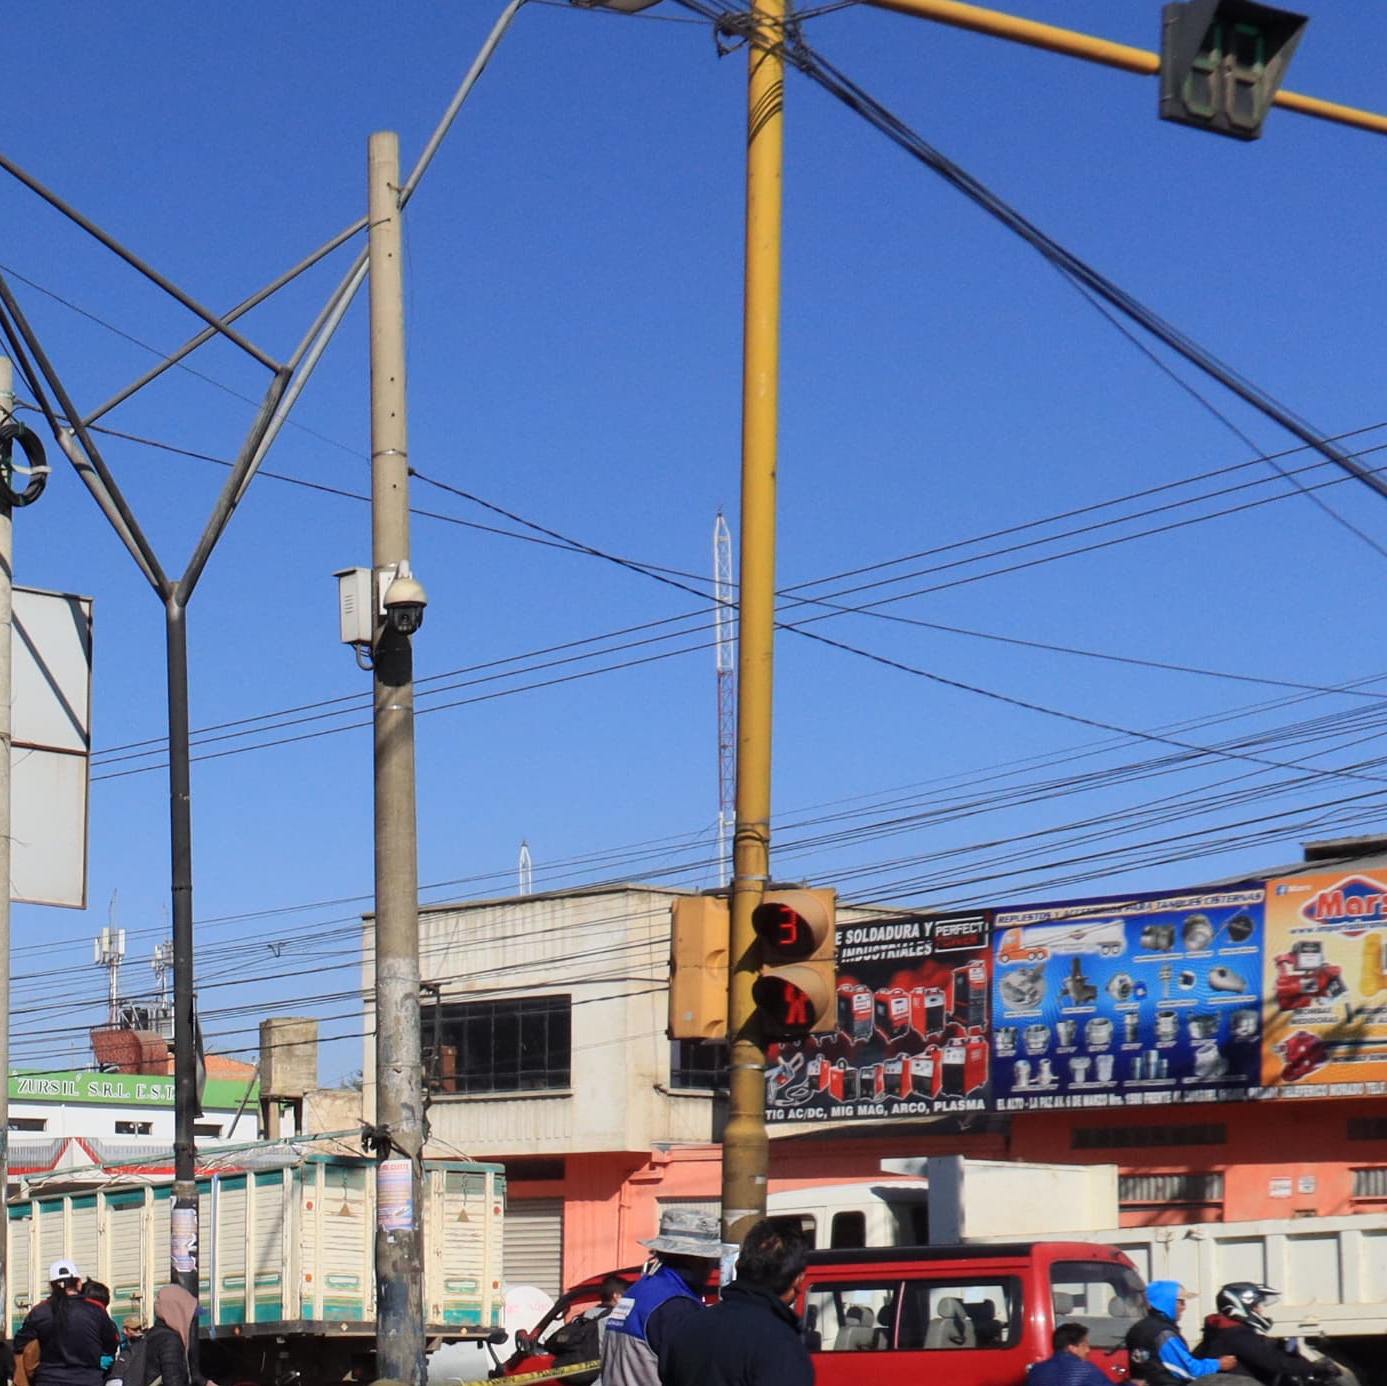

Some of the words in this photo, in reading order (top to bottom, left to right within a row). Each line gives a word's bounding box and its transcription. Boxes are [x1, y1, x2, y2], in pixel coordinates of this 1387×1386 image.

[997, 911, 1052, 924] REPUESTOS
[1203, 892, 1263, 906] CISTERNAS
[845, 922, 920, 945] SOLDADURA
[924, 920, 934, 937] Y
[935, 921, 984, 938] PERFECT
[765, 1109, 785, 1121] TIG
[788, 1107, 827, 1120] AC/DC,
[831, 1105, 854, 1117] MIG
[857, 1103, 888, 1117] MAG,
[891, 1101, 930, 1115] ARCO,
[933, 1098, 986, 1112] PLASMA
[1007, 1097, 1025, 1110] ALTO
[1083, 1094, 1108, 1107] MARZO
